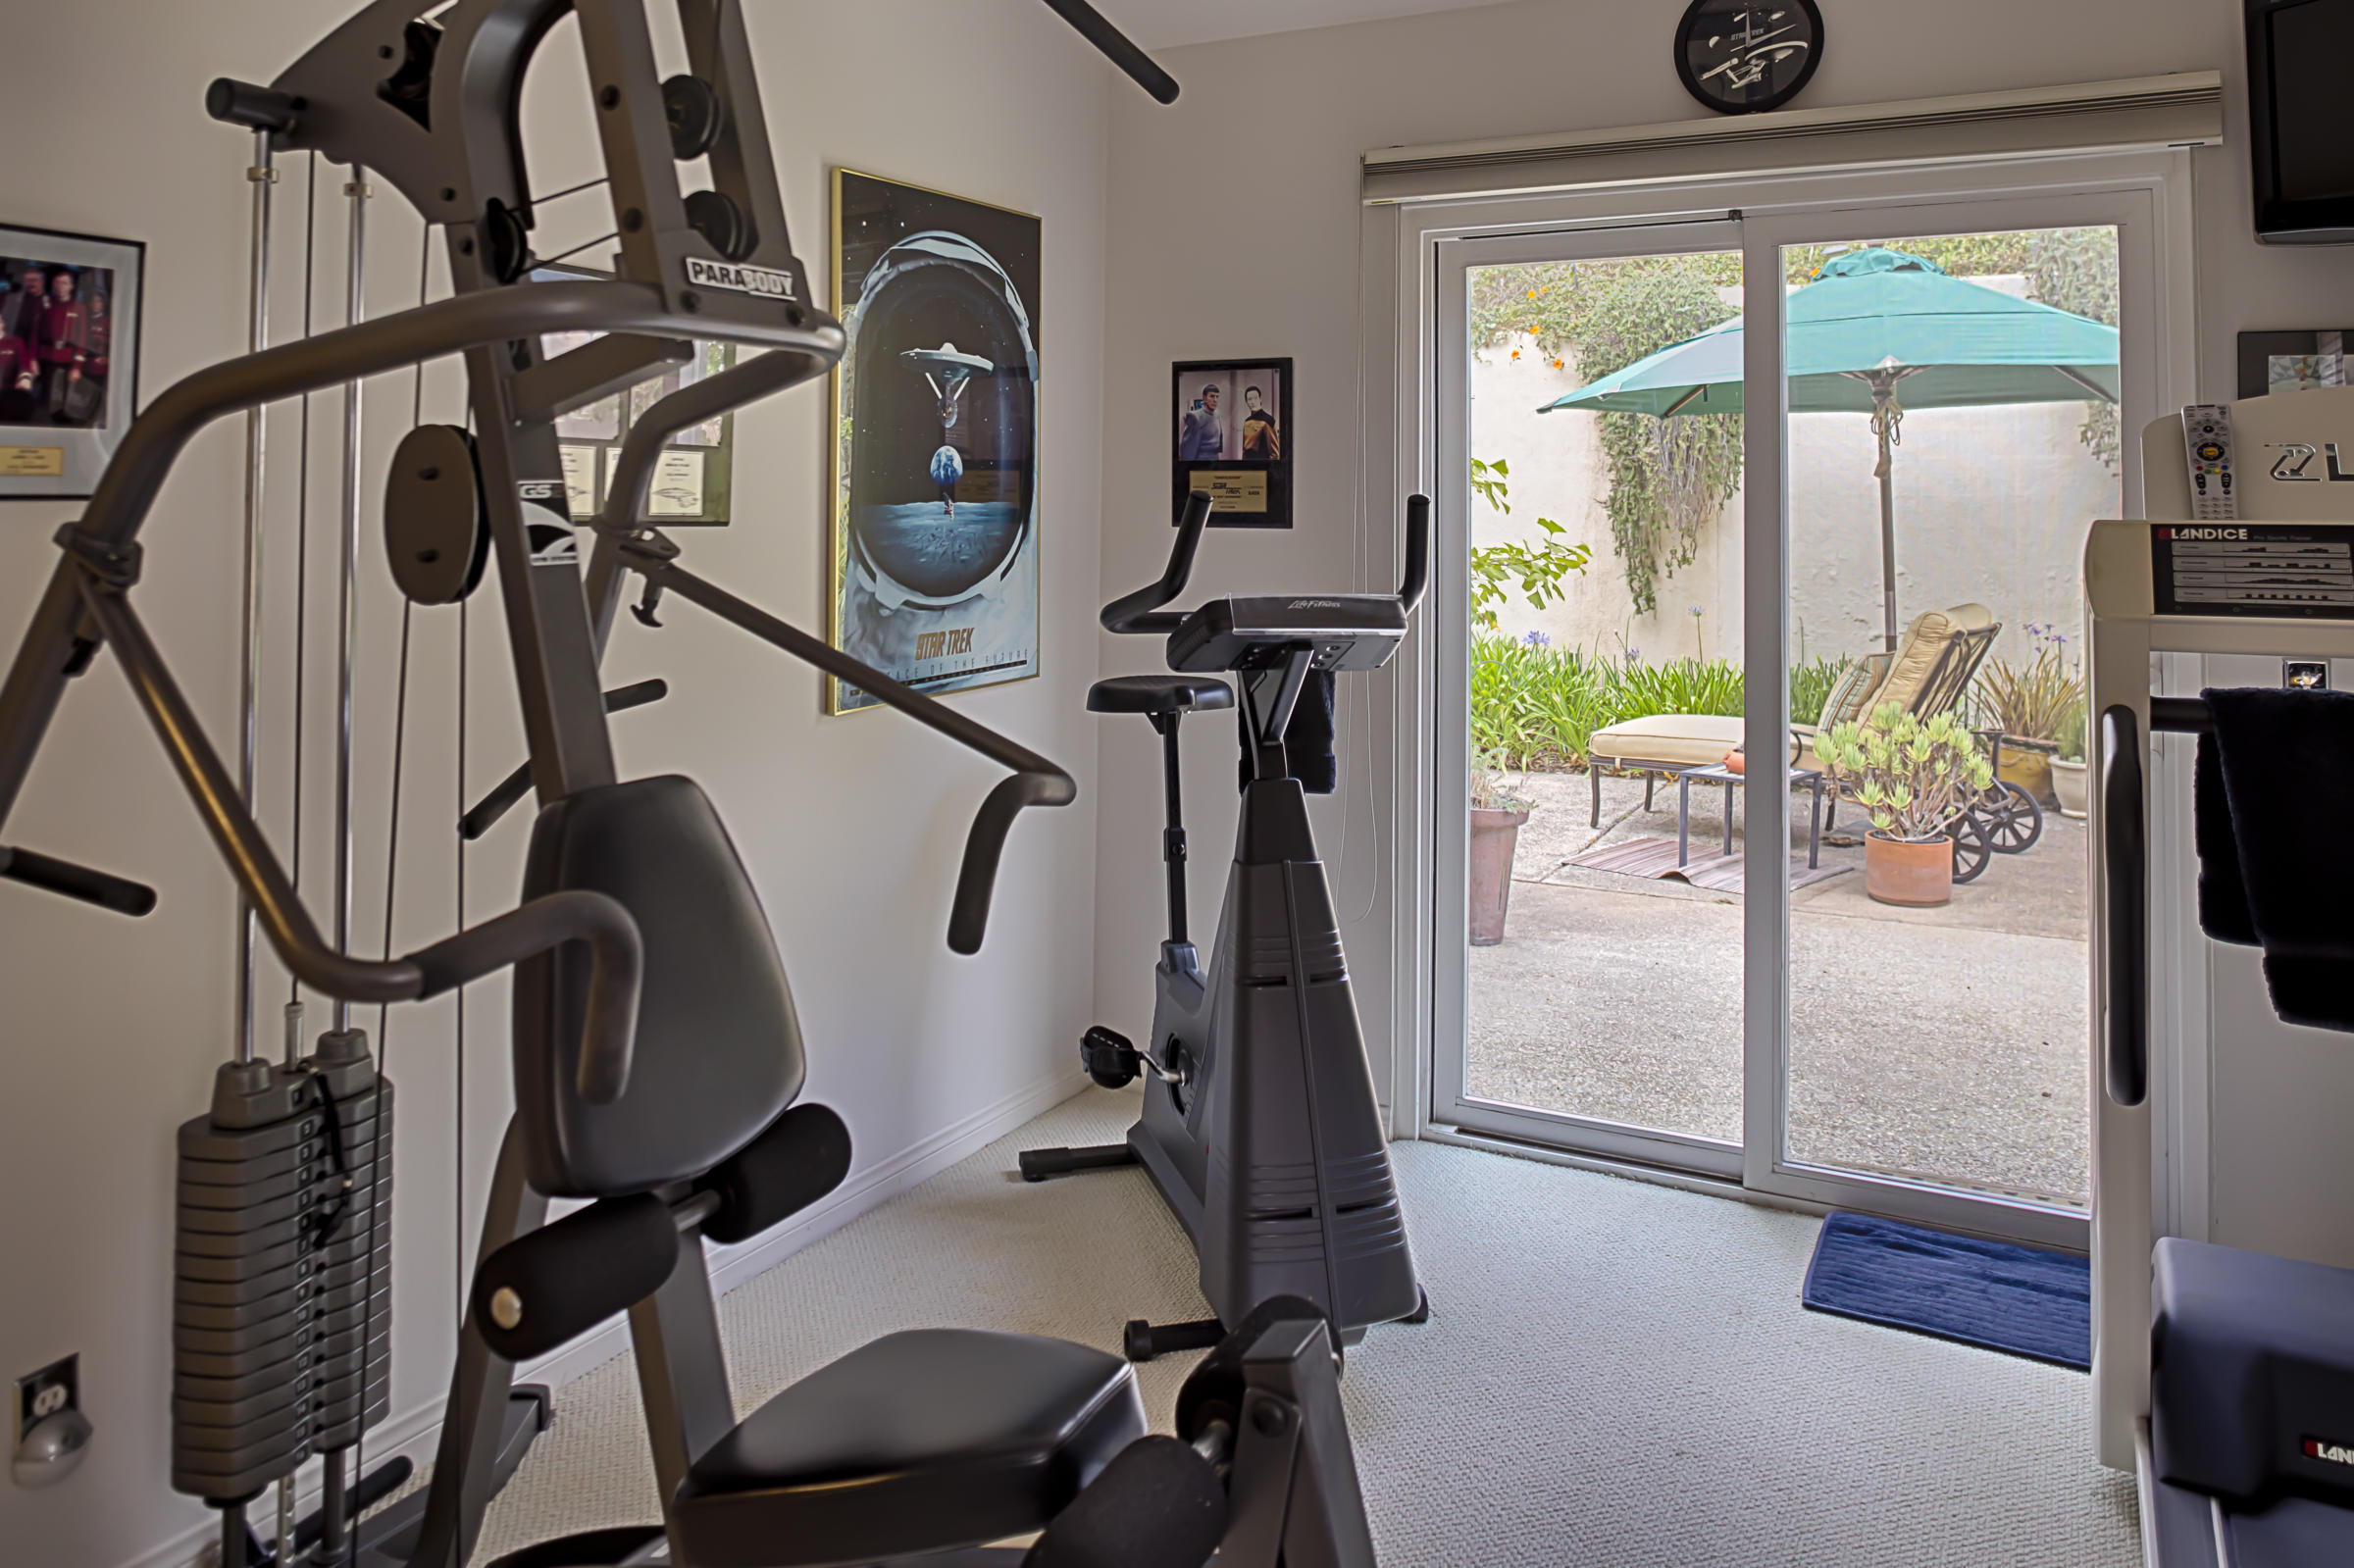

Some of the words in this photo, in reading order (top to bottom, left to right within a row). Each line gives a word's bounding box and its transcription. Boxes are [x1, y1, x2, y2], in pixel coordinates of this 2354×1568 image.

[691, 261, 793, 295] PARABODY
[2172, 528, 2248, 540] LANDICE
[914, 631, 947, 661] STAR
[947, 627, 975, 656] TREK
[2317, 1442, 2354, 1465] LAN
